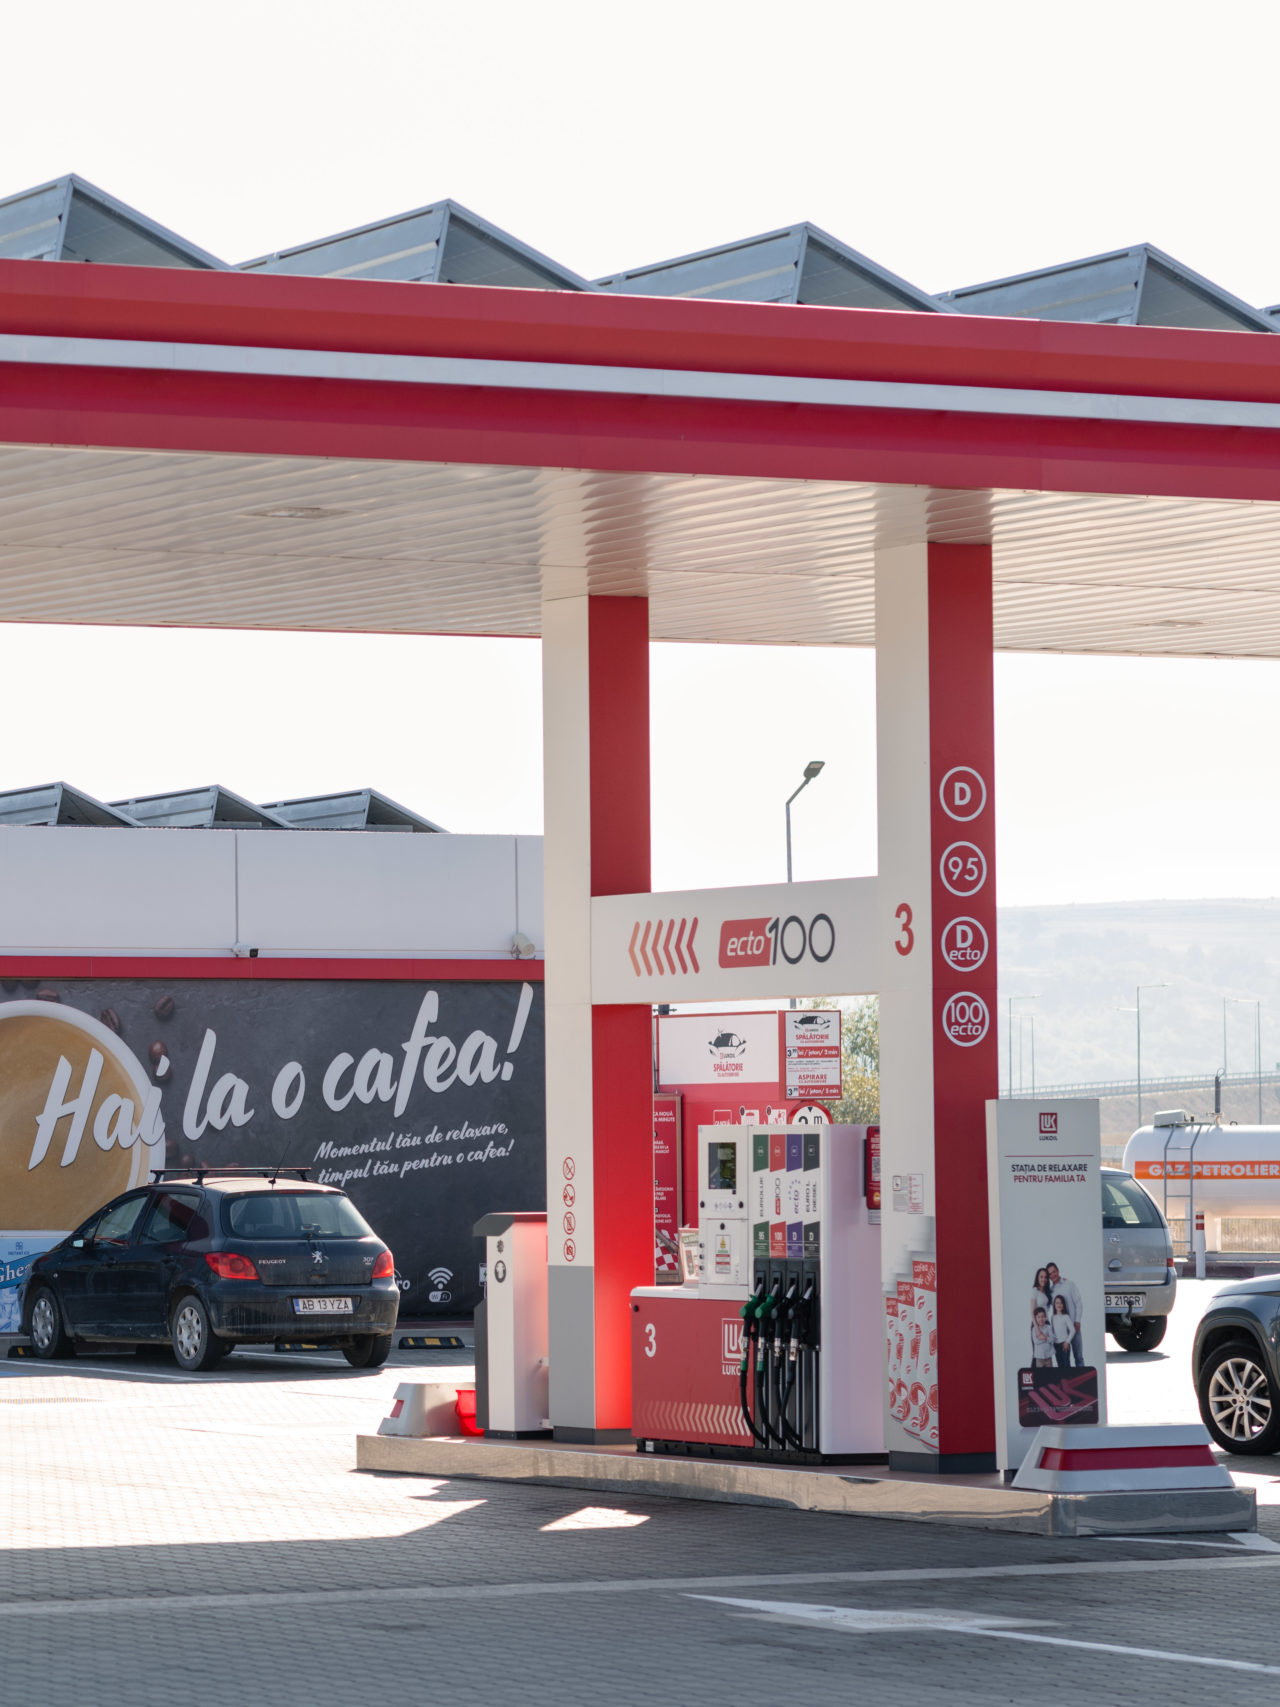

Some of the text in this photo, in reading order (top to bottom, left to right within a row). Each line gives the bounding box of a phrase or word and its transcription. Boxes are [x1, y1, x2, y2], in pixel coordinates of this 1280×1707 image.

[953, 782, 971, 806] D
[948, 856, 979, 881] 95
[726, 913, 836, 965] ecto 100
[894, 902, 914, 956] 3
[955, 924, 973, 948] D
[949, 947, 981, 960] ecto
[950, 1001, 983, 1023] 100
[950, 1022, 982, 1036] ecto
[28, 982, 534, 1171] Hai la o cafea!
[1040, 1114, 1057, 1132] LUK
[313, 1120, 509, 1162] Momentul tău de relaxare,
[318, 1139, 515, 1187] timpul tău pentru o cafea!
[1037, 1164, 1048, 1172] DE
[1049, 1163, 1088, 1172] RELAXARE
[1148, 1164, 1280, 1176] GAZ PETROLIER
[1013, 1174, 1086, 1183] PENTRU FAMILIA TA
[302, 1298, 350, 1311] AB 13 YZA
[645, 1322, 657, 1358] 3
